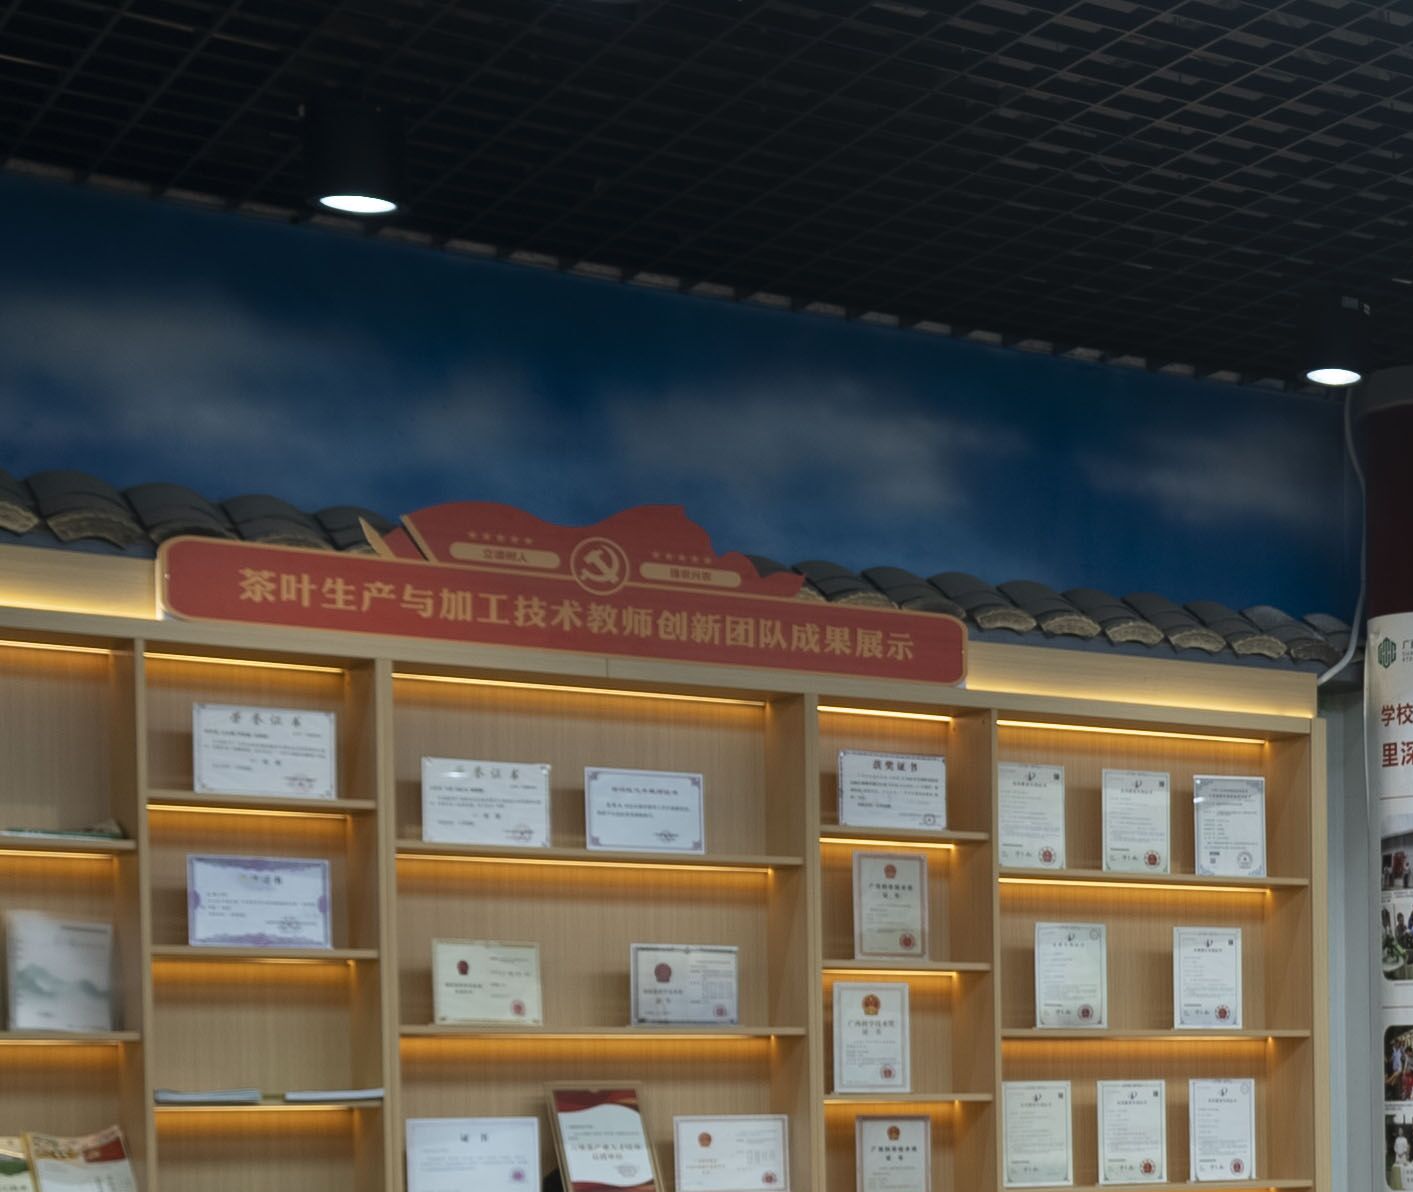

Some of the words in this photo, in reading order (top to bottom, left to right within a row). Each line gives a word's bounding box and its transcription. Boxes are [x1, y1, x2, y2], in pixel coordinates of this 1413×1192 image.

[238, 567, 914, 661] 茶叶生产与加工技术教师创新团队成果展示
[872, 757, 920, 772] 获奖证书
